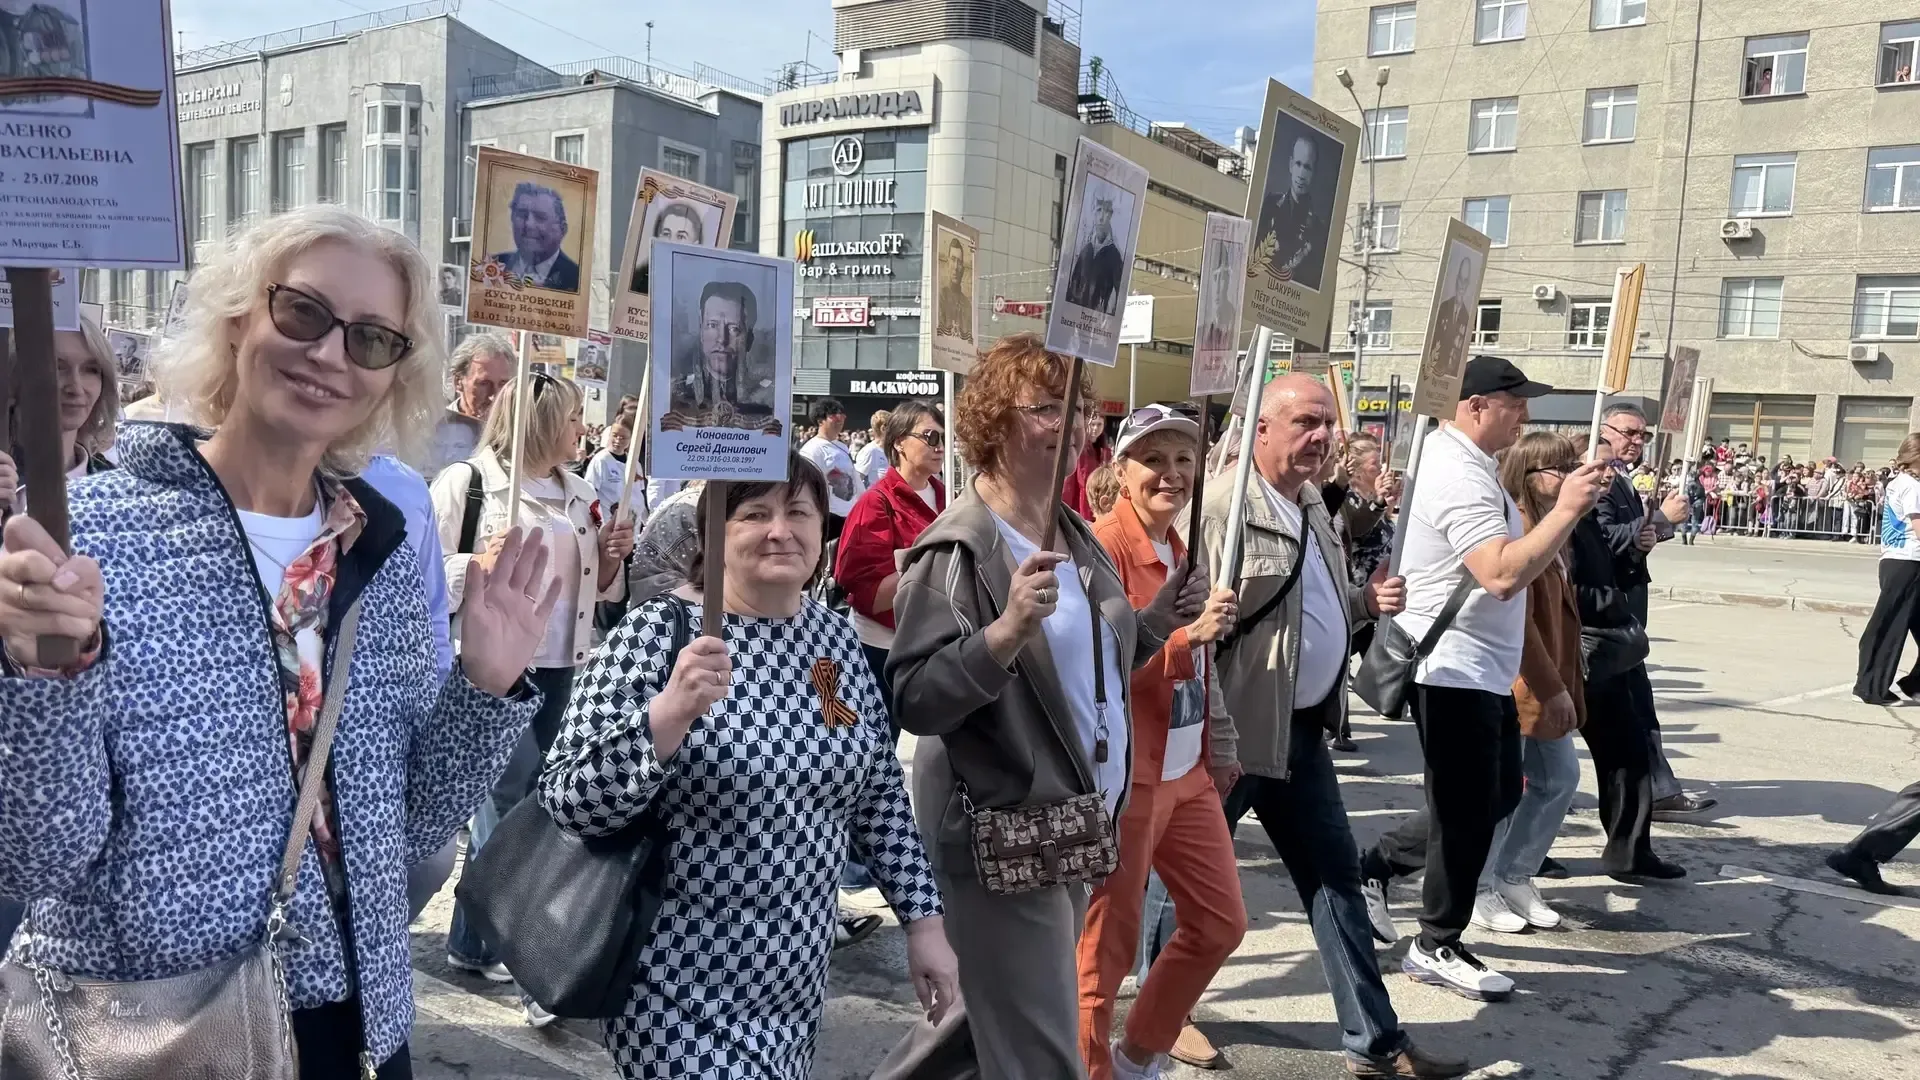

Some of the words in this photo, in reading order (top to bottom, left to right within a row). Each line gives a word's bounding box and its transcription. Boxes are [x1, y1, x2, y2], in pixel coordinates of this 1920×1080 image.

[780, 90, 922, 126] ПИРАМИДА
[0, 123, 72, 139] ЛЕНКО
[0, 145, 135, 164] ВАСИЛЬЕВНА
[23, 171, 100, 188] 25.07.2008
[802, 183, 826, 209] ART
[836, 178, 896, 206] LOUNGE
[799, 264, 823, 279] бар
[828, 262, 838, 276] &
[844, 264, 892, 278] гриль
[1267, 277, 1301, 300] ШАКУРИН
[483, 299, 516, 312] Макар
[484, 289, 575, 310] КУСТАРОВСКИЙ
[895, 371, 937, 382] кофейня
[850, 380, 939, 395] BLACKWOOD
[696, 429, 750, 441] Коновалов
[676, 442, 712, 454] Сергей
[712, 444, 768, 455] Данилович
[680, 464, 711, 473] Северный
